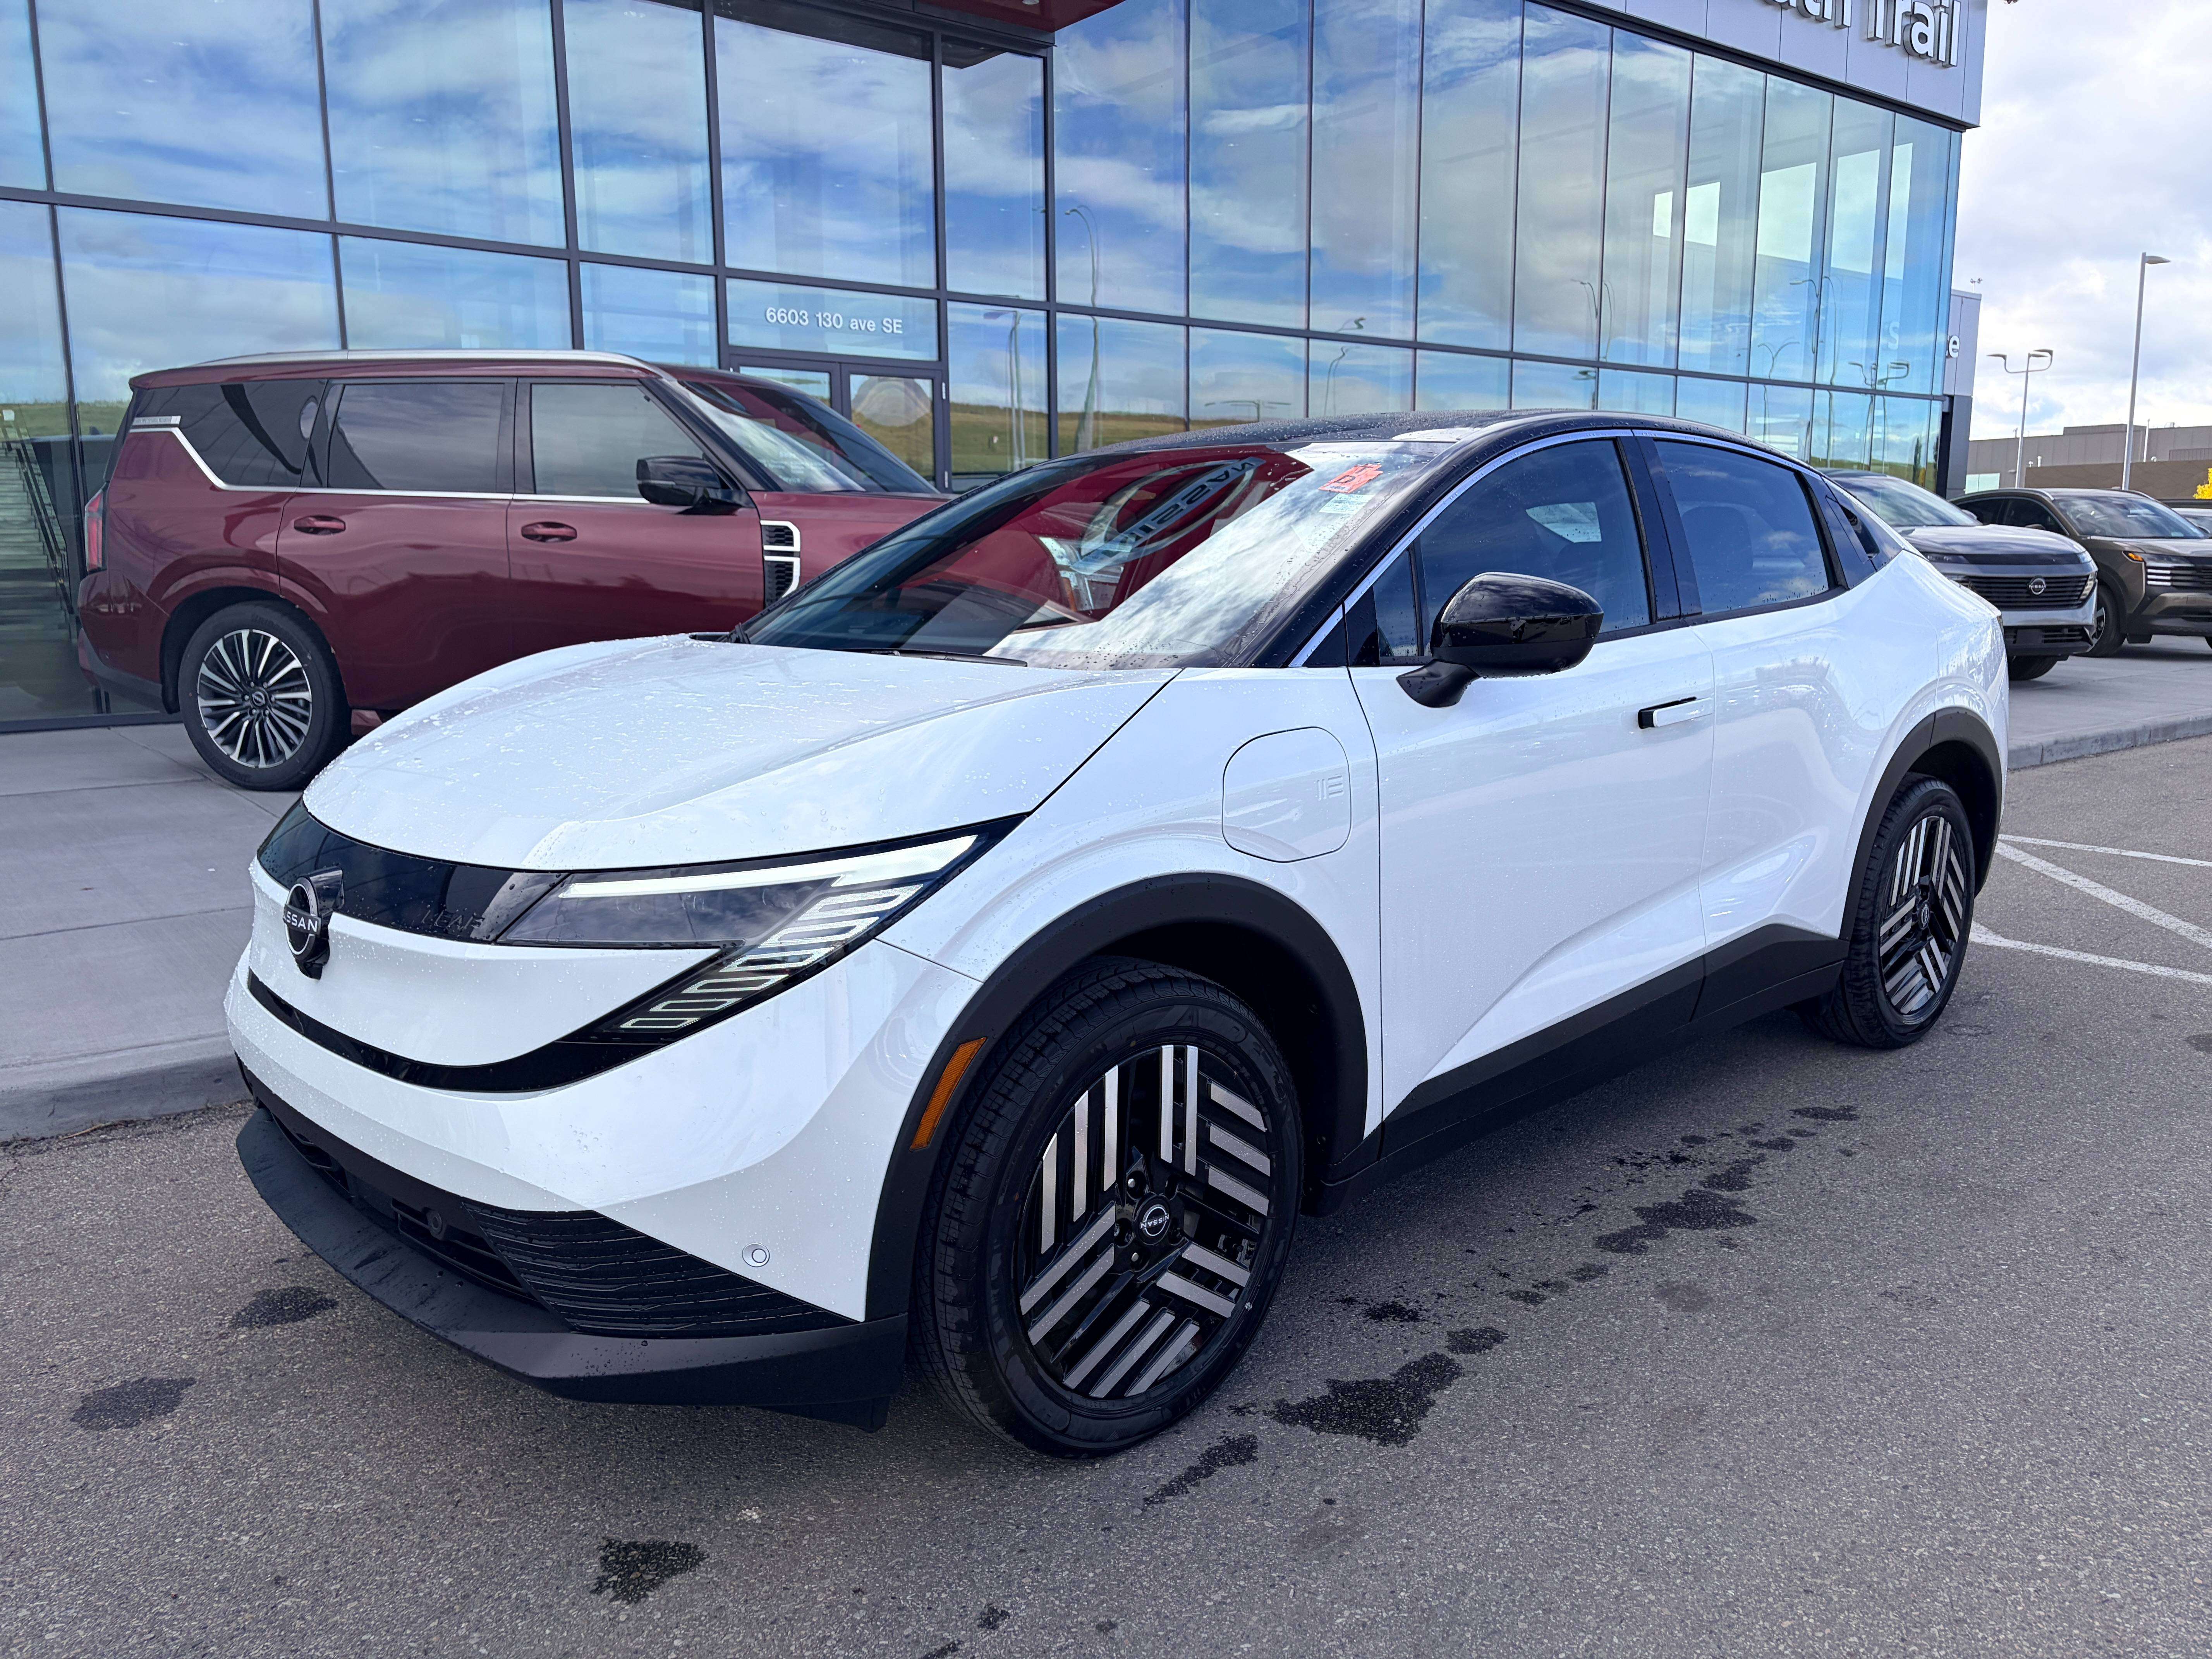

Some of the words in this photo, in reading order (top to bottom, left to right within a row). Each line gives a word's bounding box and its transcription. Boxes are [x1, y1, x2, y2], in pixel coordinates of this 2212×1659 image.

[766, 307, 809, 326] 6603
[815, 312, 843, 329] 130
[850, 318, 876, 331] ave
[882, 318, 903, 334] SE
[283, 911, 318, 932] SSAN
[1140, 1214, 1170, 1229] NISSAN
